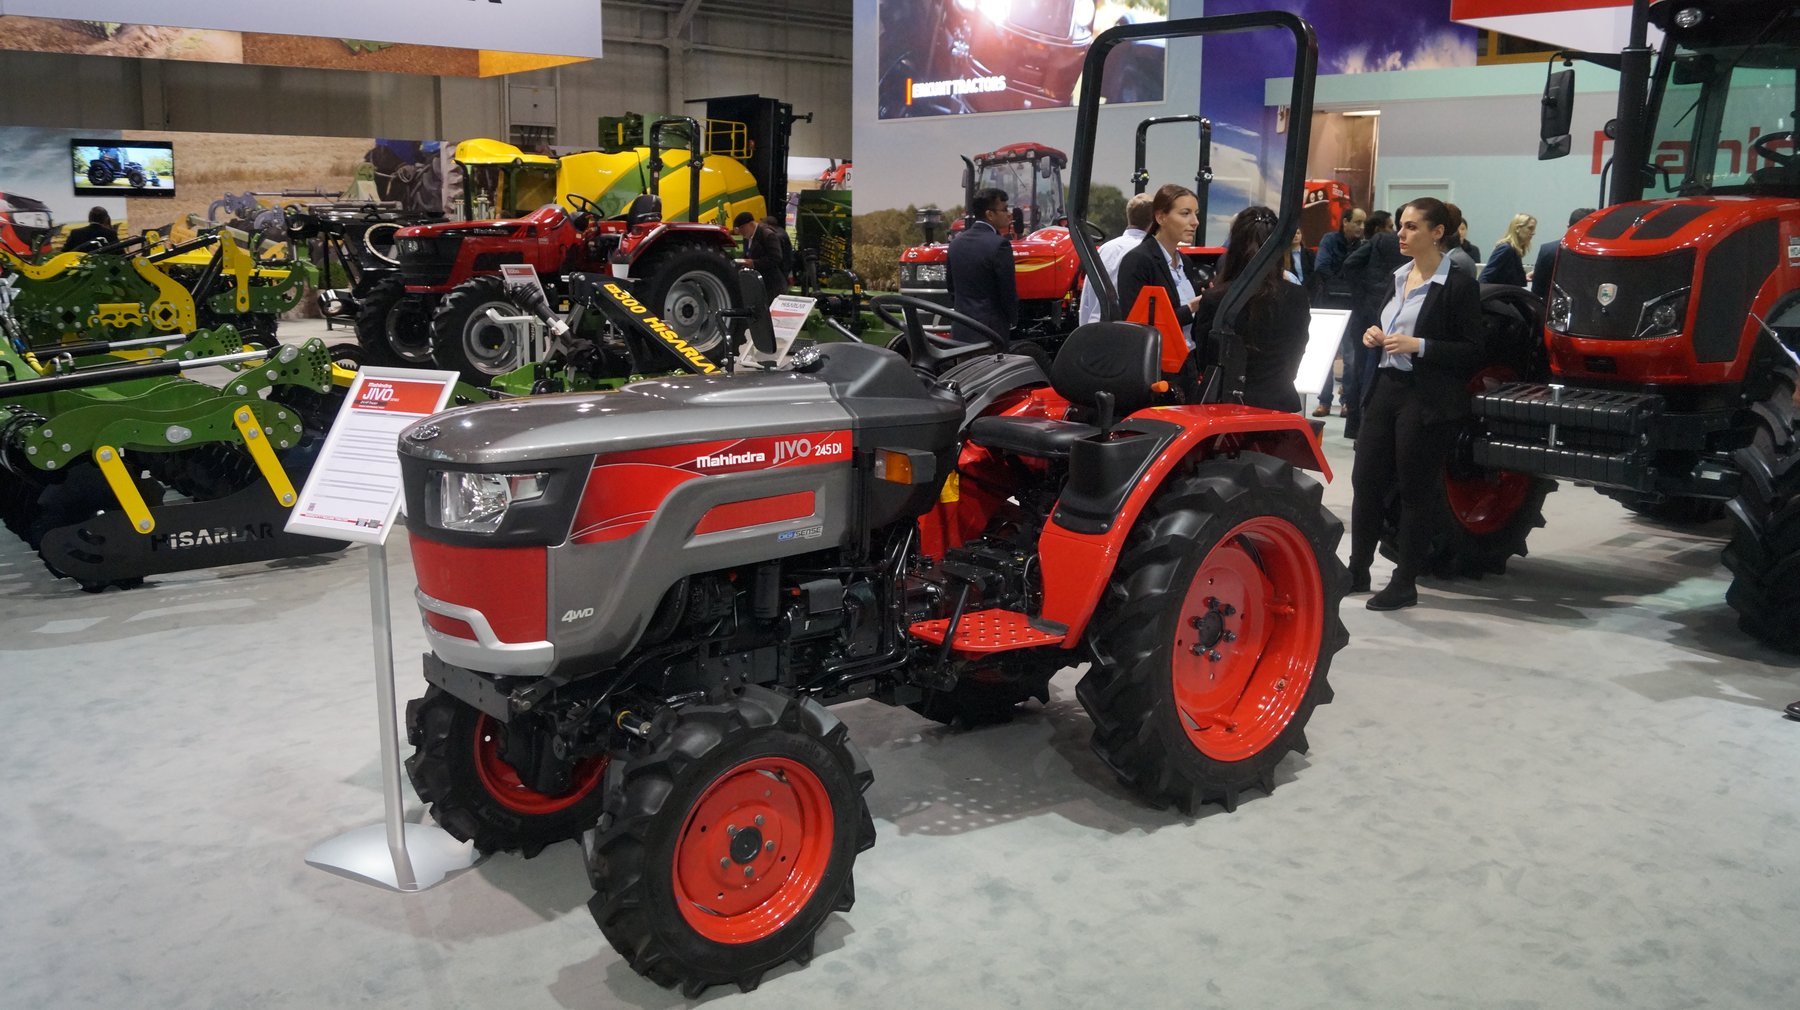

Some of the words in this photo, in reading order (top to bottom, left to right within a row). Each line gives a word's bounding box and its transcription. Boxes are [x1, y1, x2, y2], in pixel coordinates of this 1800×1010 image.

[362, 387, 394, 401] JIVO
[696, 452, 765, 468] Mahindra
[772, 438, 812, 464] JIVO
[561, 607, 594, 622] 4WD
